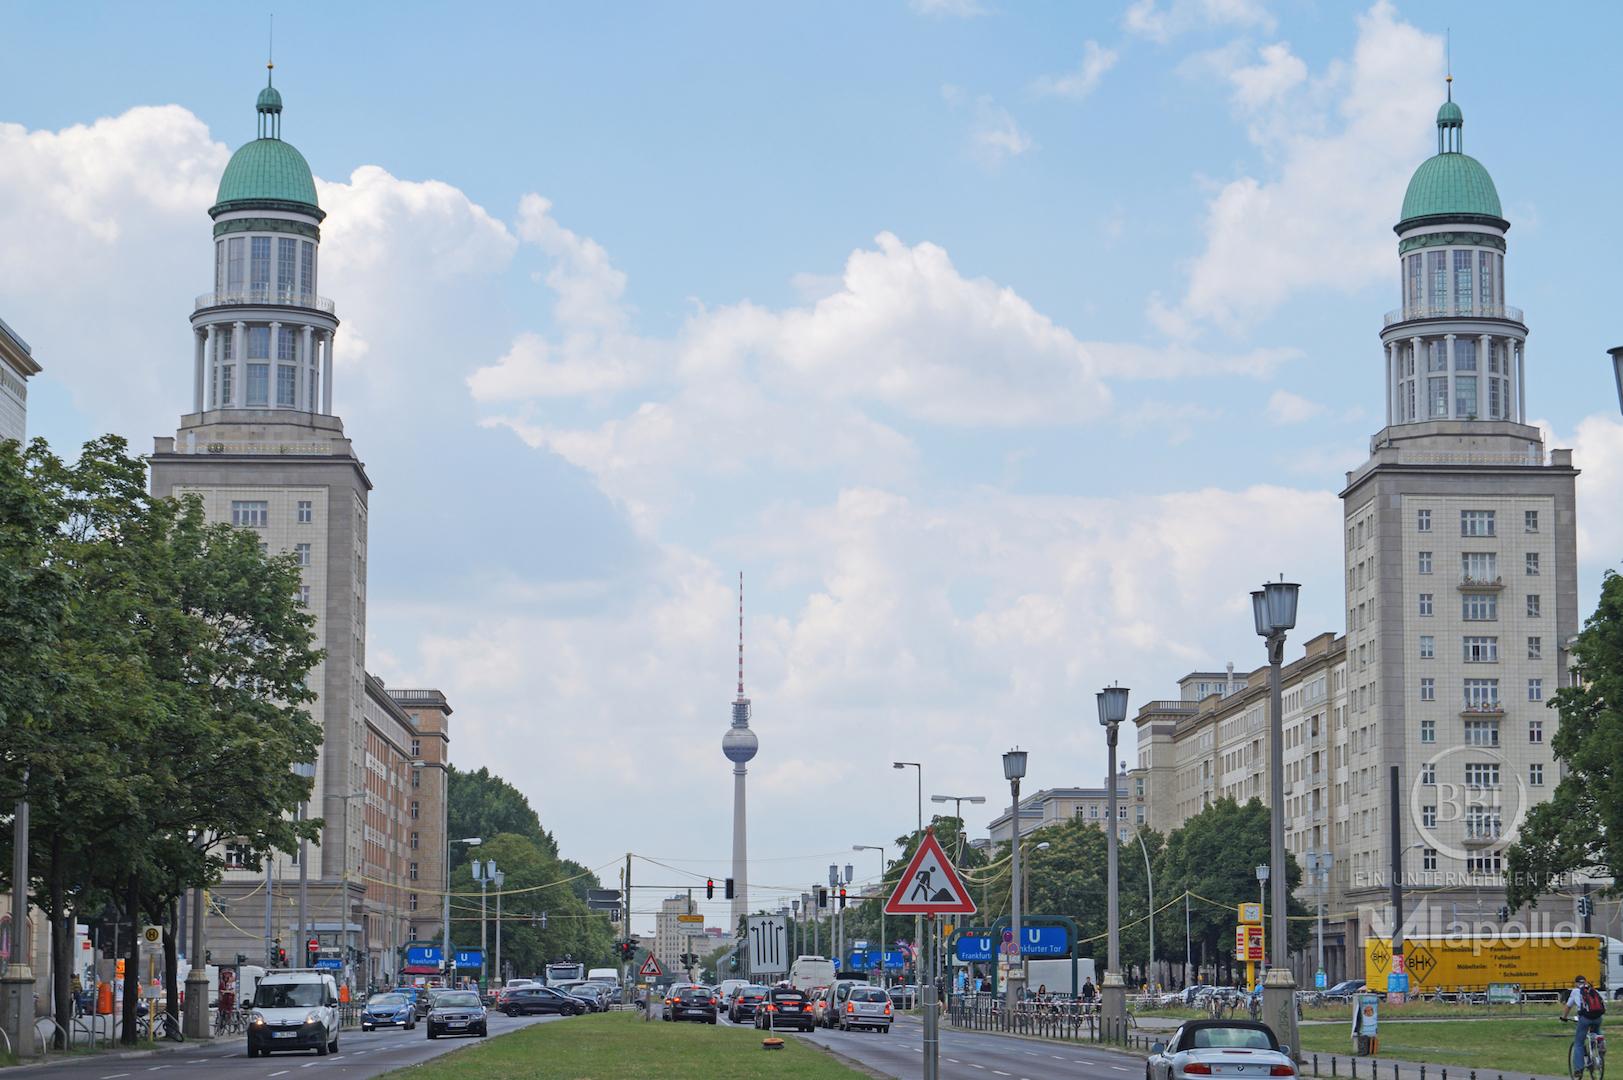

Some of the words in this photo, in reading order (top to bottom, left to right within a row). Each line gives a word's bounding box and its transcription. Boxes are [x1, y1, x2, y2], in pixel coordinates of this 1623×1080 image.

[1028, 929, 1041, 943] U
[980, 938, 990, 951] U
[1050, 945, 1061, 953] Tor
[425, 949, 432, 958] U
[461, 953, 467, 961] U
[884, 953, 891, 961] U
[962, 952, 992, 960] Frankfurt
[1373, 950, 1388, 964] BHK
[1408, 955, 1433, 971] BHK
